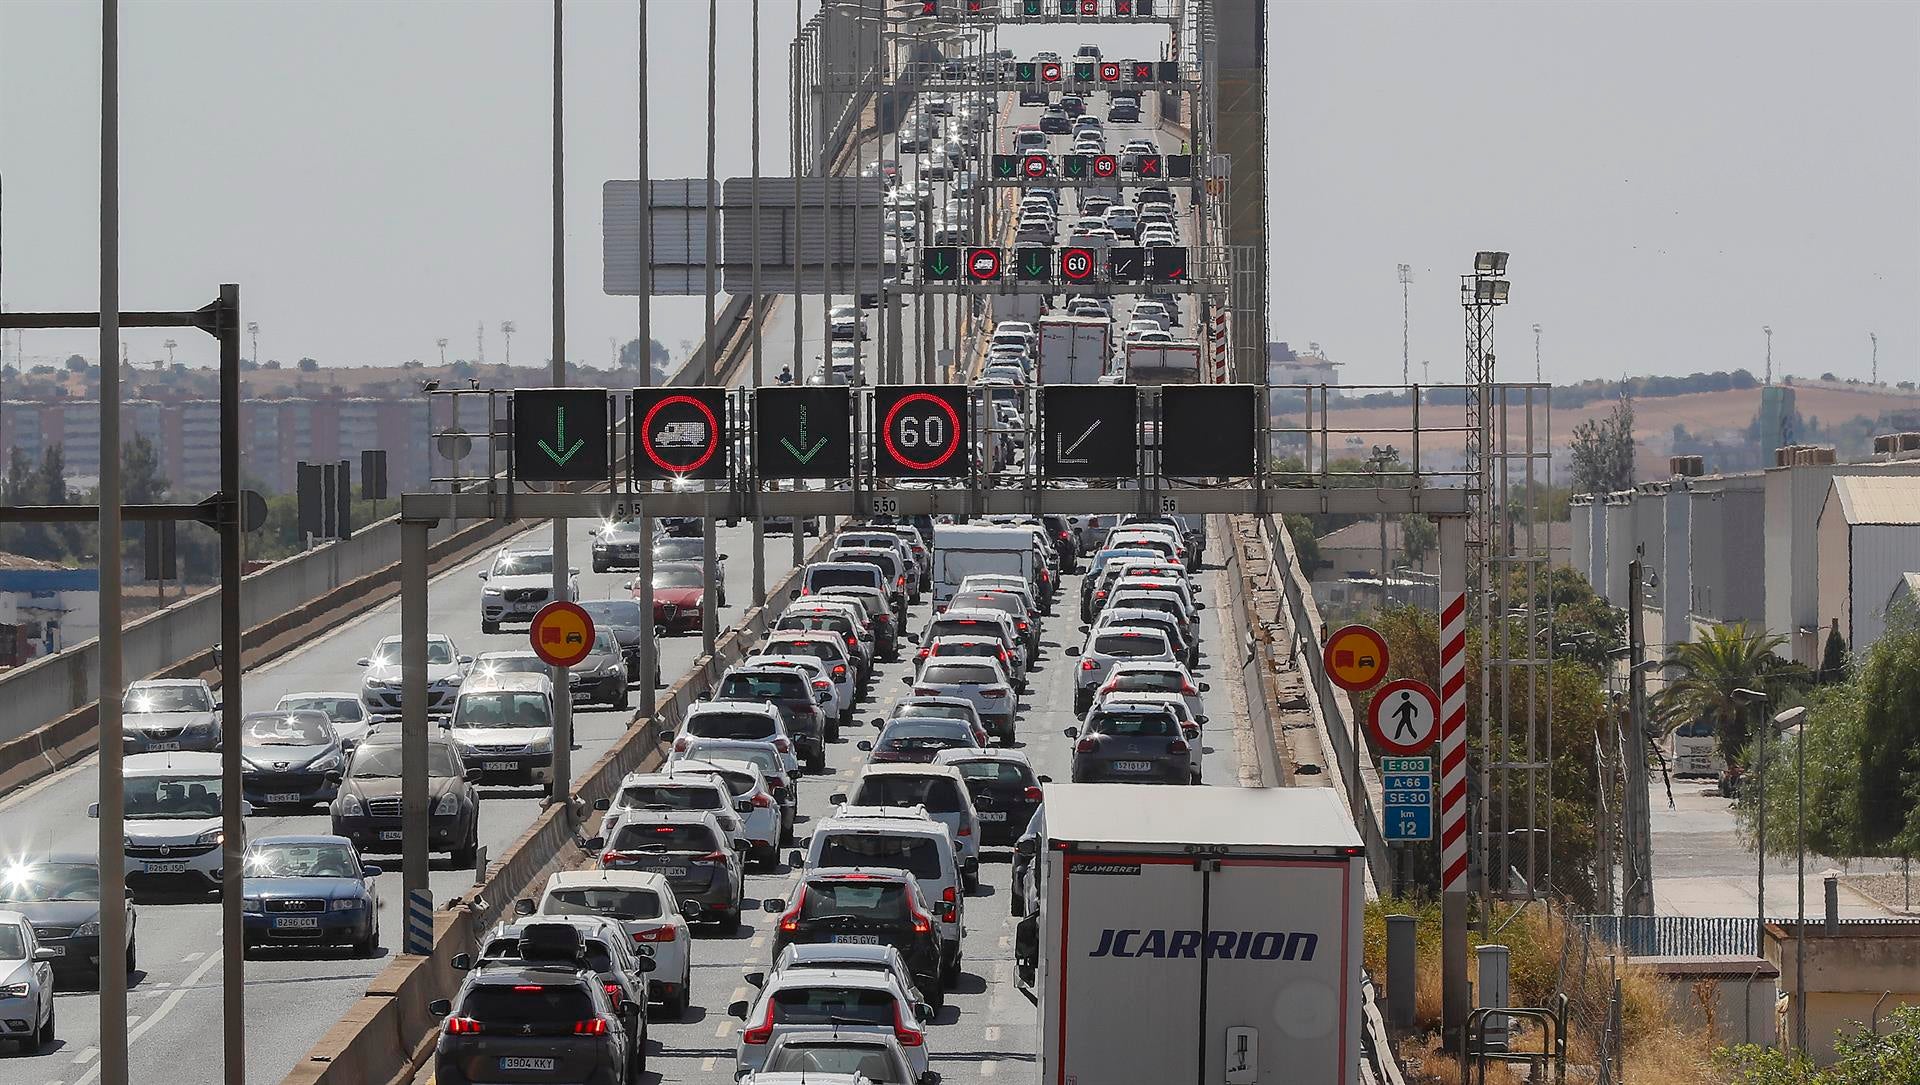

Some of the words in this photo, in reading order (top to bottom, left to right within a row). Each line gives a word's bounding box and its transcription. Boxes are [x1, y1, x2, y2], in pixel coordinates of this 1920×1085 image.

[1104, 68, 1115, 76] 60
[1098, 161, 1111, 171] 60
[1068, 257, 1086, 271] 60
[900, 416, 943, 448] 60
[873, 500, 896, 513] 5,50
[1388, 760, 1425, 771] E-803
[1393, 778, 1422, 788] A-66
[1389, 793, 1426, 803] SE-30
[1400, 809, 1415, 819] km
[1399, 821, 1417, 836] 12
[277, 918, 298, 927] 8296
[837, 935, 858, 945] 6615
[860, 935, 876, 945] GYG
[1089, 929, 1319, 962] JCARRION
[507, 1058, 531, 1069] 3904
[534, 1058, 553, 1069] KKY
